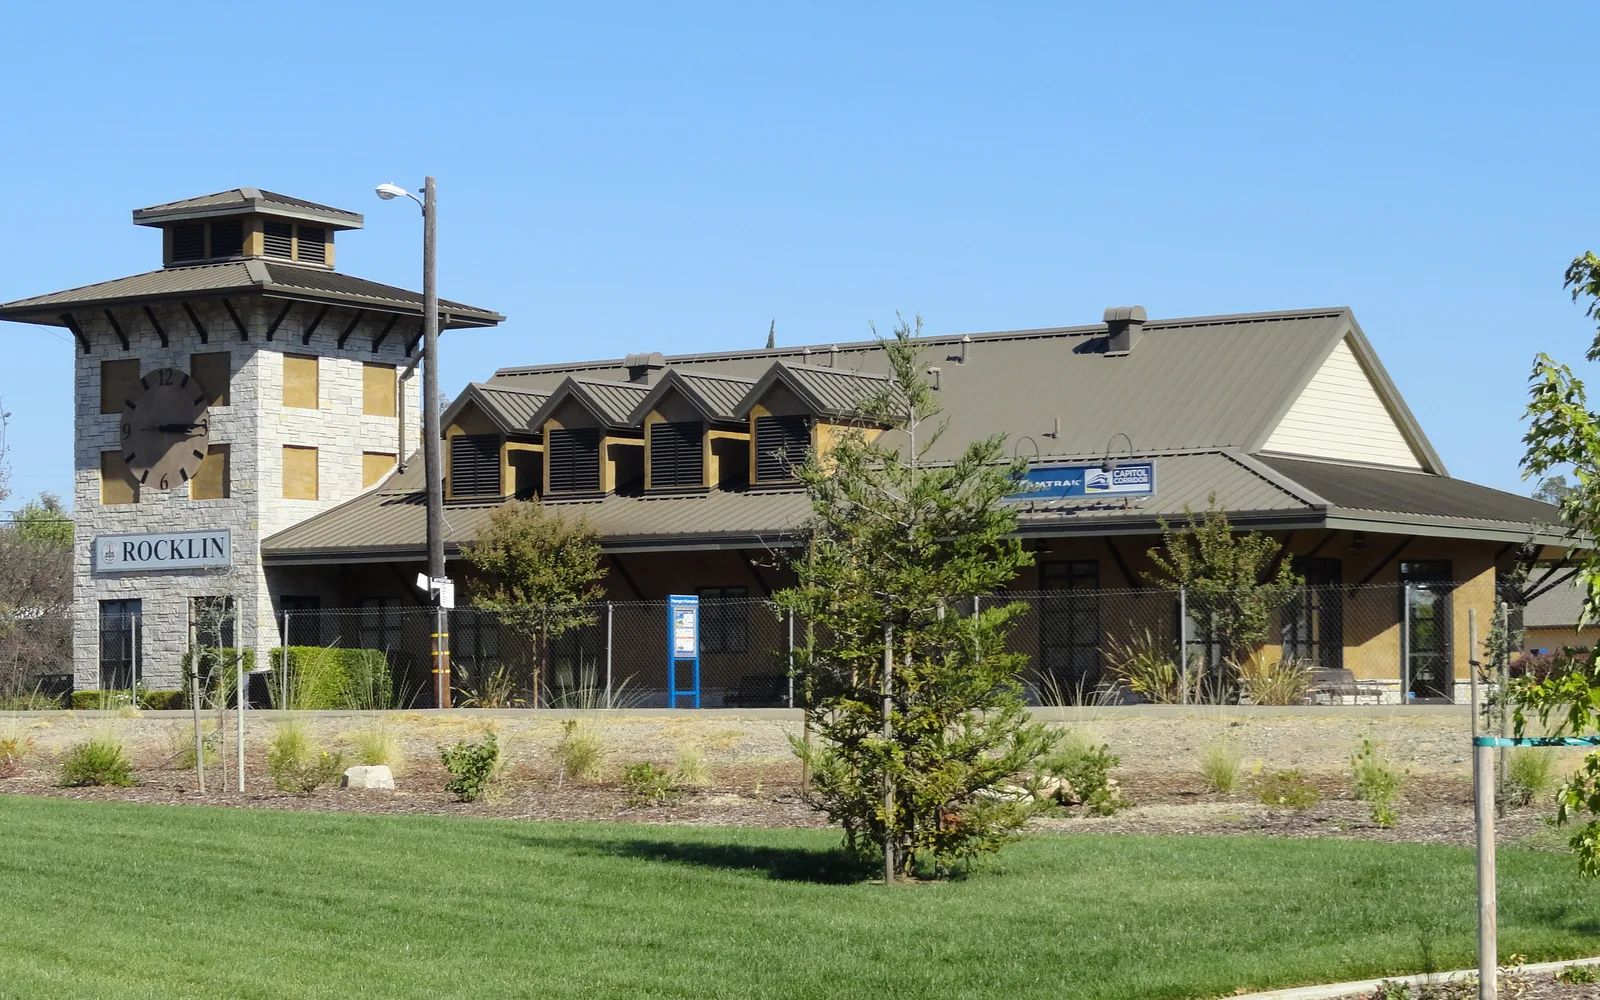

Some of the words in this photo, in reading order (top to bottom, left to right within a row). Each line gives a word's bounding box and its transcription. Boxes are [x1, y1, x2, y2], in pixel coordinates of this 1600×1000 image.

[157, 367, 174, 386] 12
[122, 422, 132, 441] 9
[198, 418, 208, 437] 3
[159, 472, 169, 491] 6
[1113, 469, 1149, 478] CAPITOL
[1113, 476, 1149, 484] CORRIDOR
[121, 536, 226, 562] ROCKLIN
